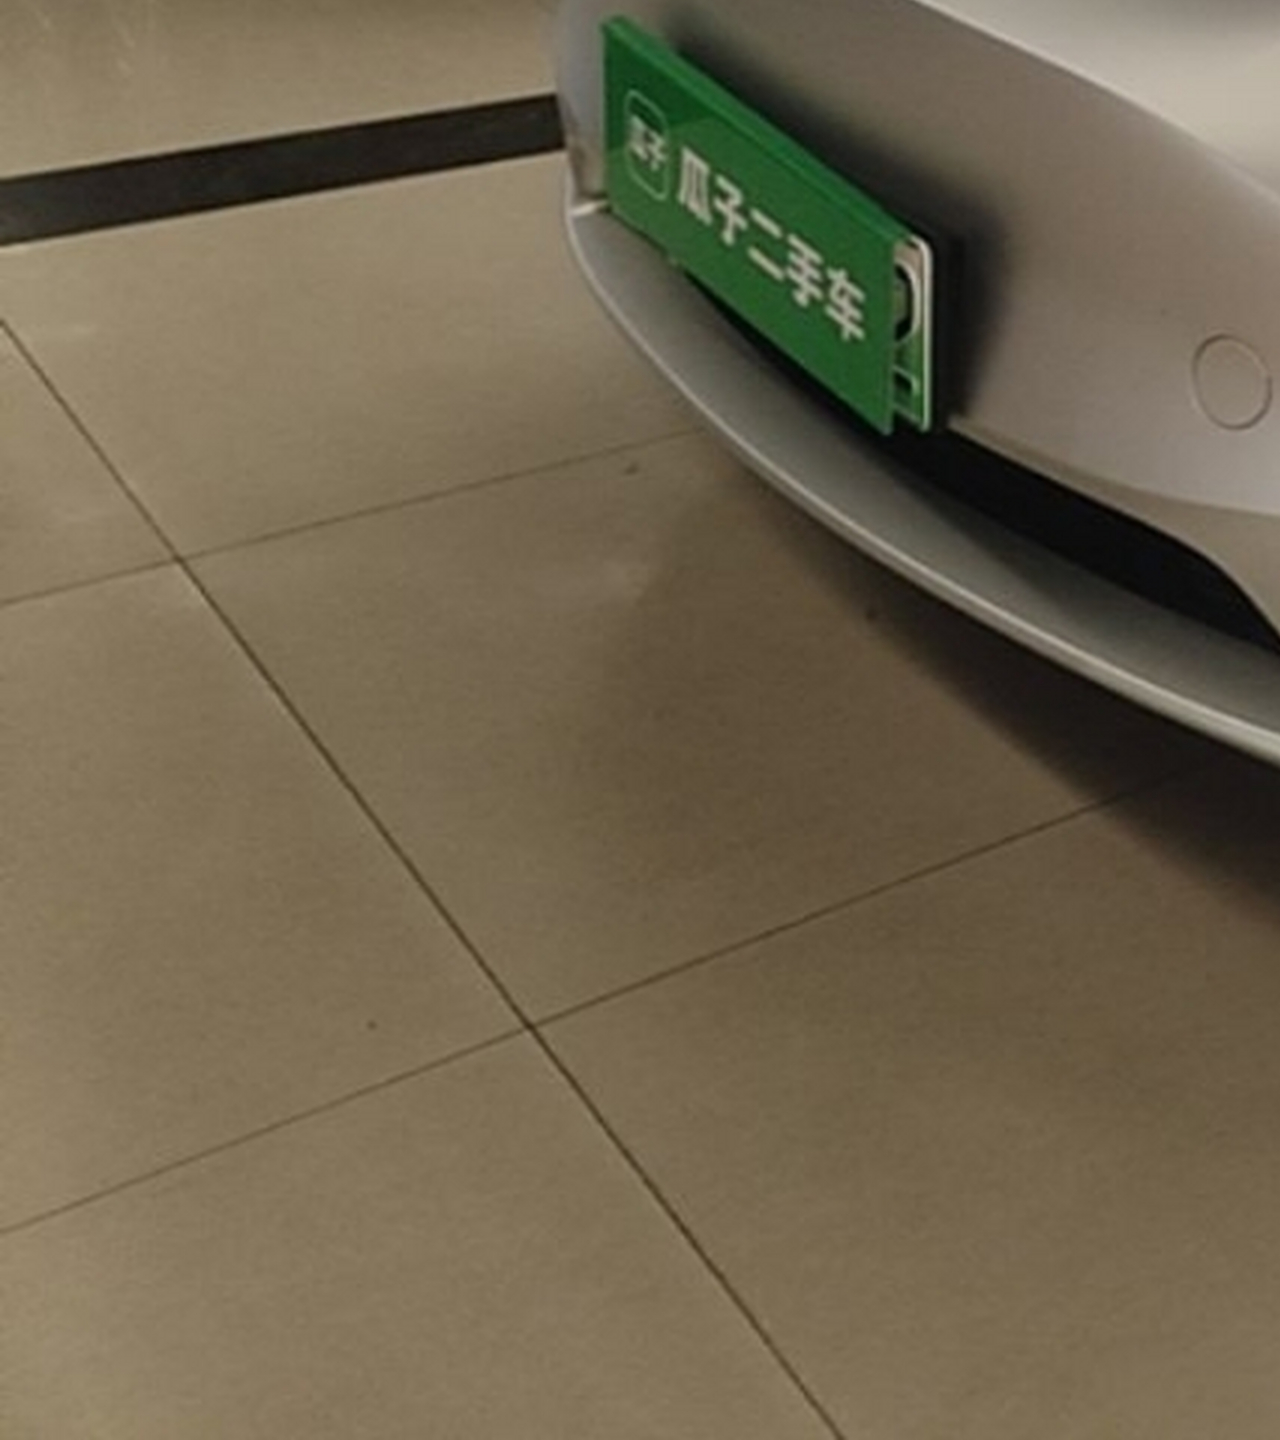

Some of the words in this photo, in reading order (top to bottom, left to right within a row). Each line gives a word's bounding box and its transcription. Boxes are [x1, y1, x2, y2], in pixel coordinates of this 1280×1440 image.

[677, 146, 867, 342] 瓜子二手车
